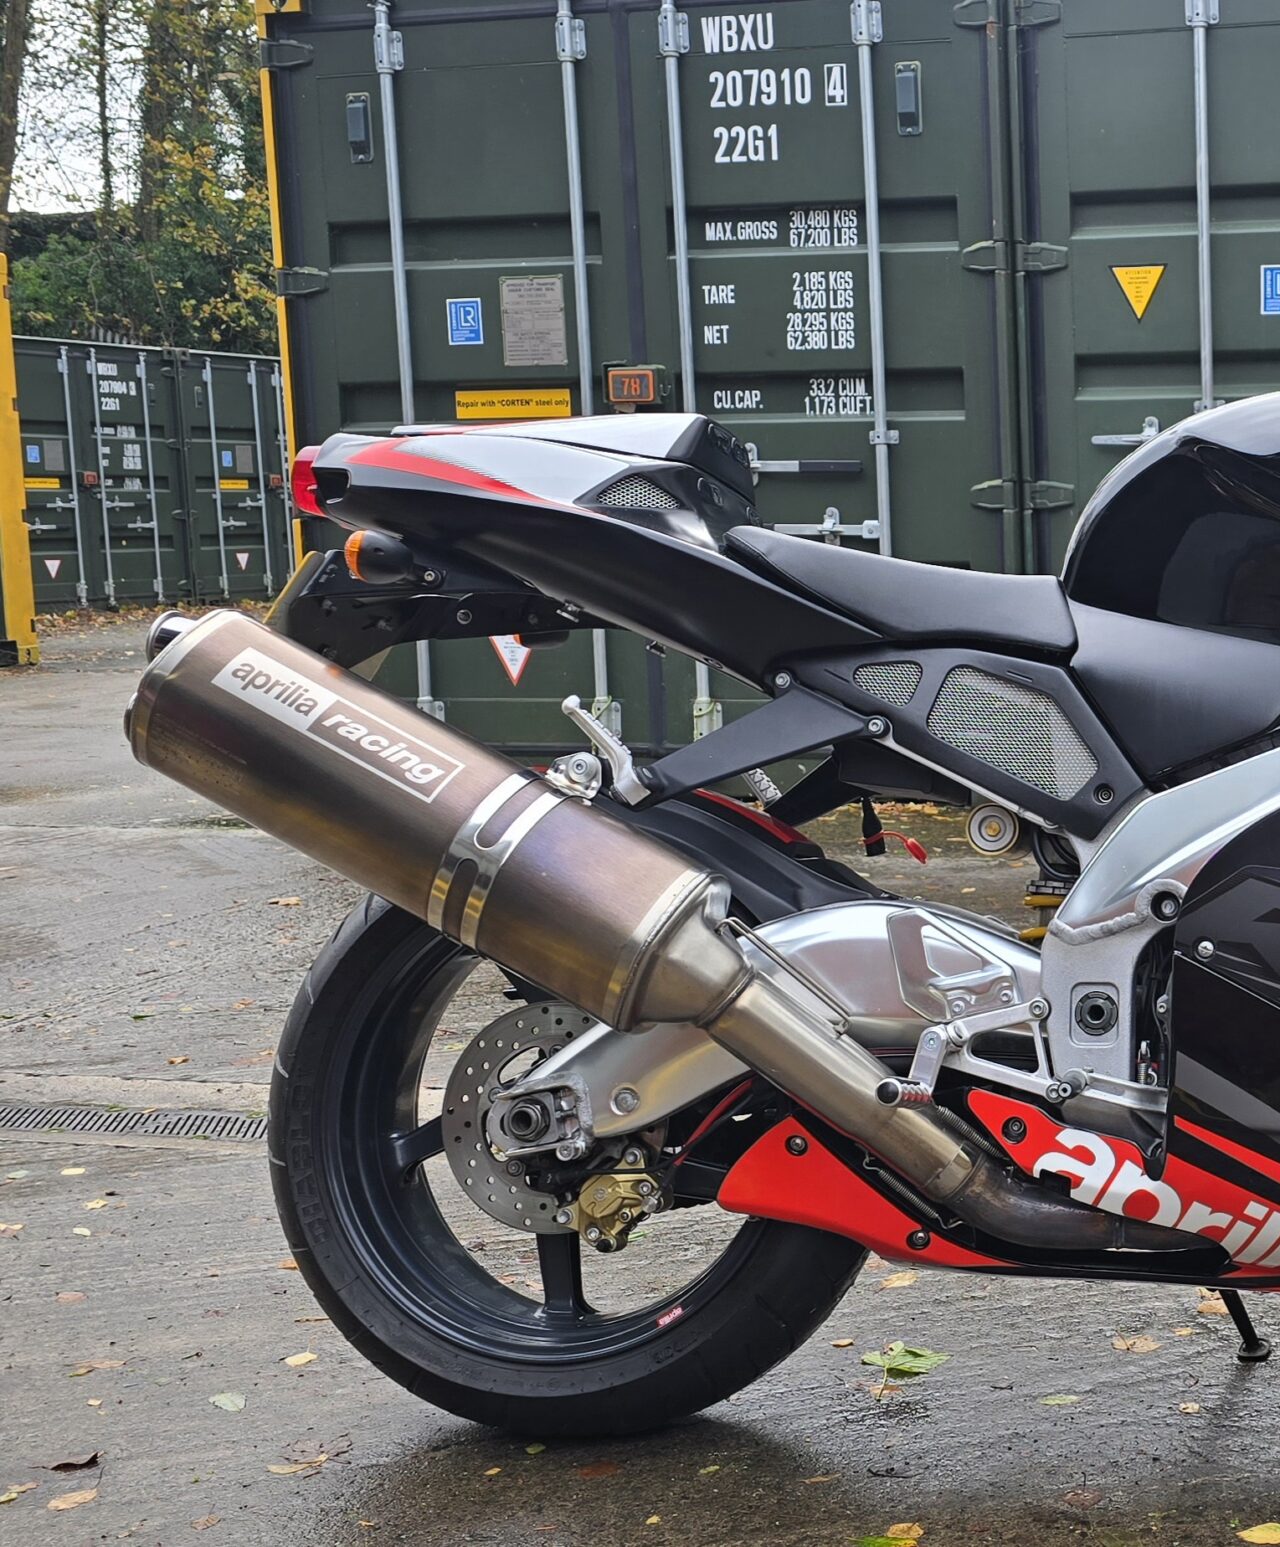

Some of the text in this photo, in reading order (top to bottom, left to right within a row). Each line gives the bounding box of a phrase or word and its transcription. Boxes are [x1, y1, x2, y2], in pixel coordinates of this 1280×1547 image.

[701, 12, 774, 54] WBXU
[709, 65, 845, 108] 207910 4
[713, 124, 779, 163] 22G1
[705, 221, 778, 241] MAX.GROSS
[833, 209, 858, 228] KGS
[833, 227, 858, 247] LBS
[702, 284, 736, 304] TARE
[829, 271, 854, 290] KGS
[829, 289, 854, 309] LBS
[704, 325, 729, 344] NET
[830, 311, 855, 331] KGS
[831, 330, 856, 349] LBS
[457, 400, 479, 409] Repair
[481, 399, 496, 408] with
[535, 398, 553, 406] steel
[555, 398, 569, 408] only
[713, 390, 763, 409] CU.CAP.
[231, 662, 446, 785] aprilia racing
